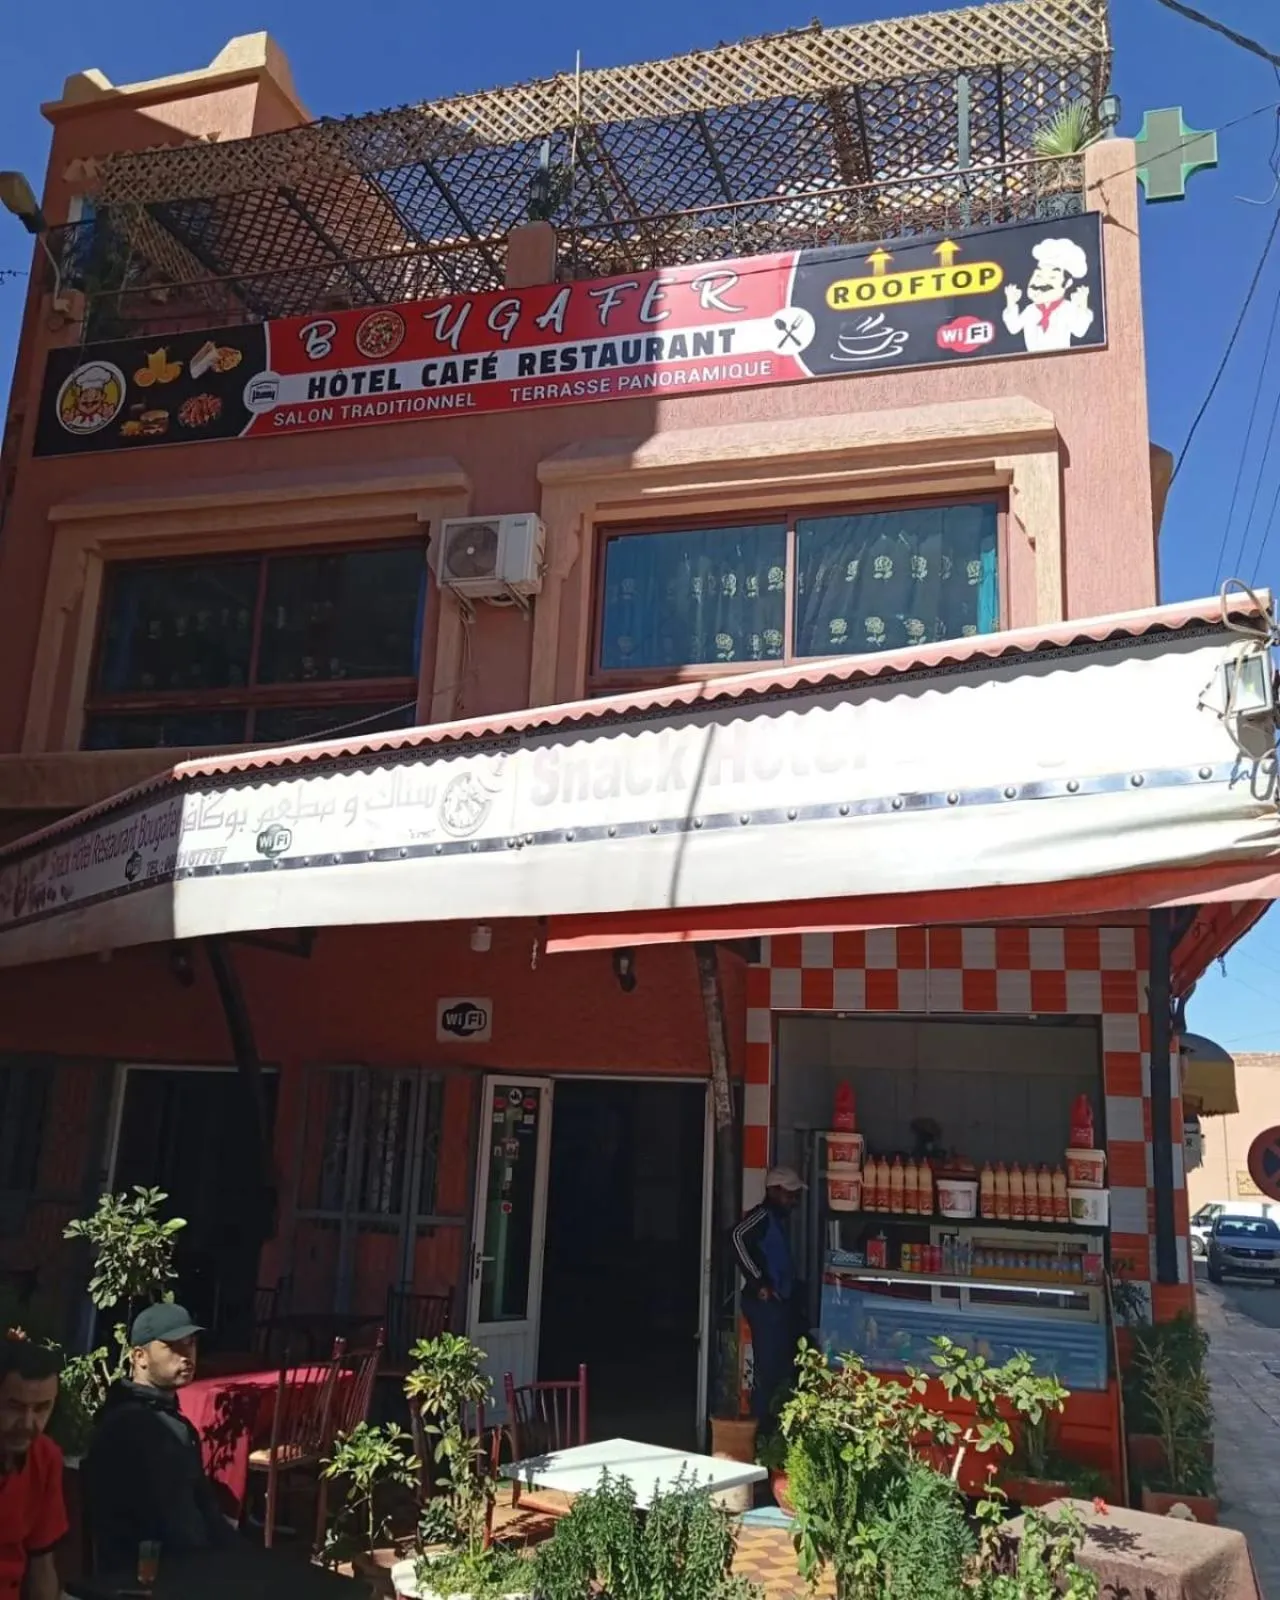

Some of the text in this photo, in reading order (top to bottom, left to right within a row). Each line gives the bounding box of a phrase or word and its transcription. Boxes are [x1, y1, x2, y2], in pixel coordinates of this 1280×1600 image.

[833, 267, 995, 304] ROOFTOP
[273, 360, 772, 426] SALON TRADITIONNEL TERRASSE PANORAMIQUE
[307, 327, 736, 400] HÔTEL CAFÉ RESTAURANT
